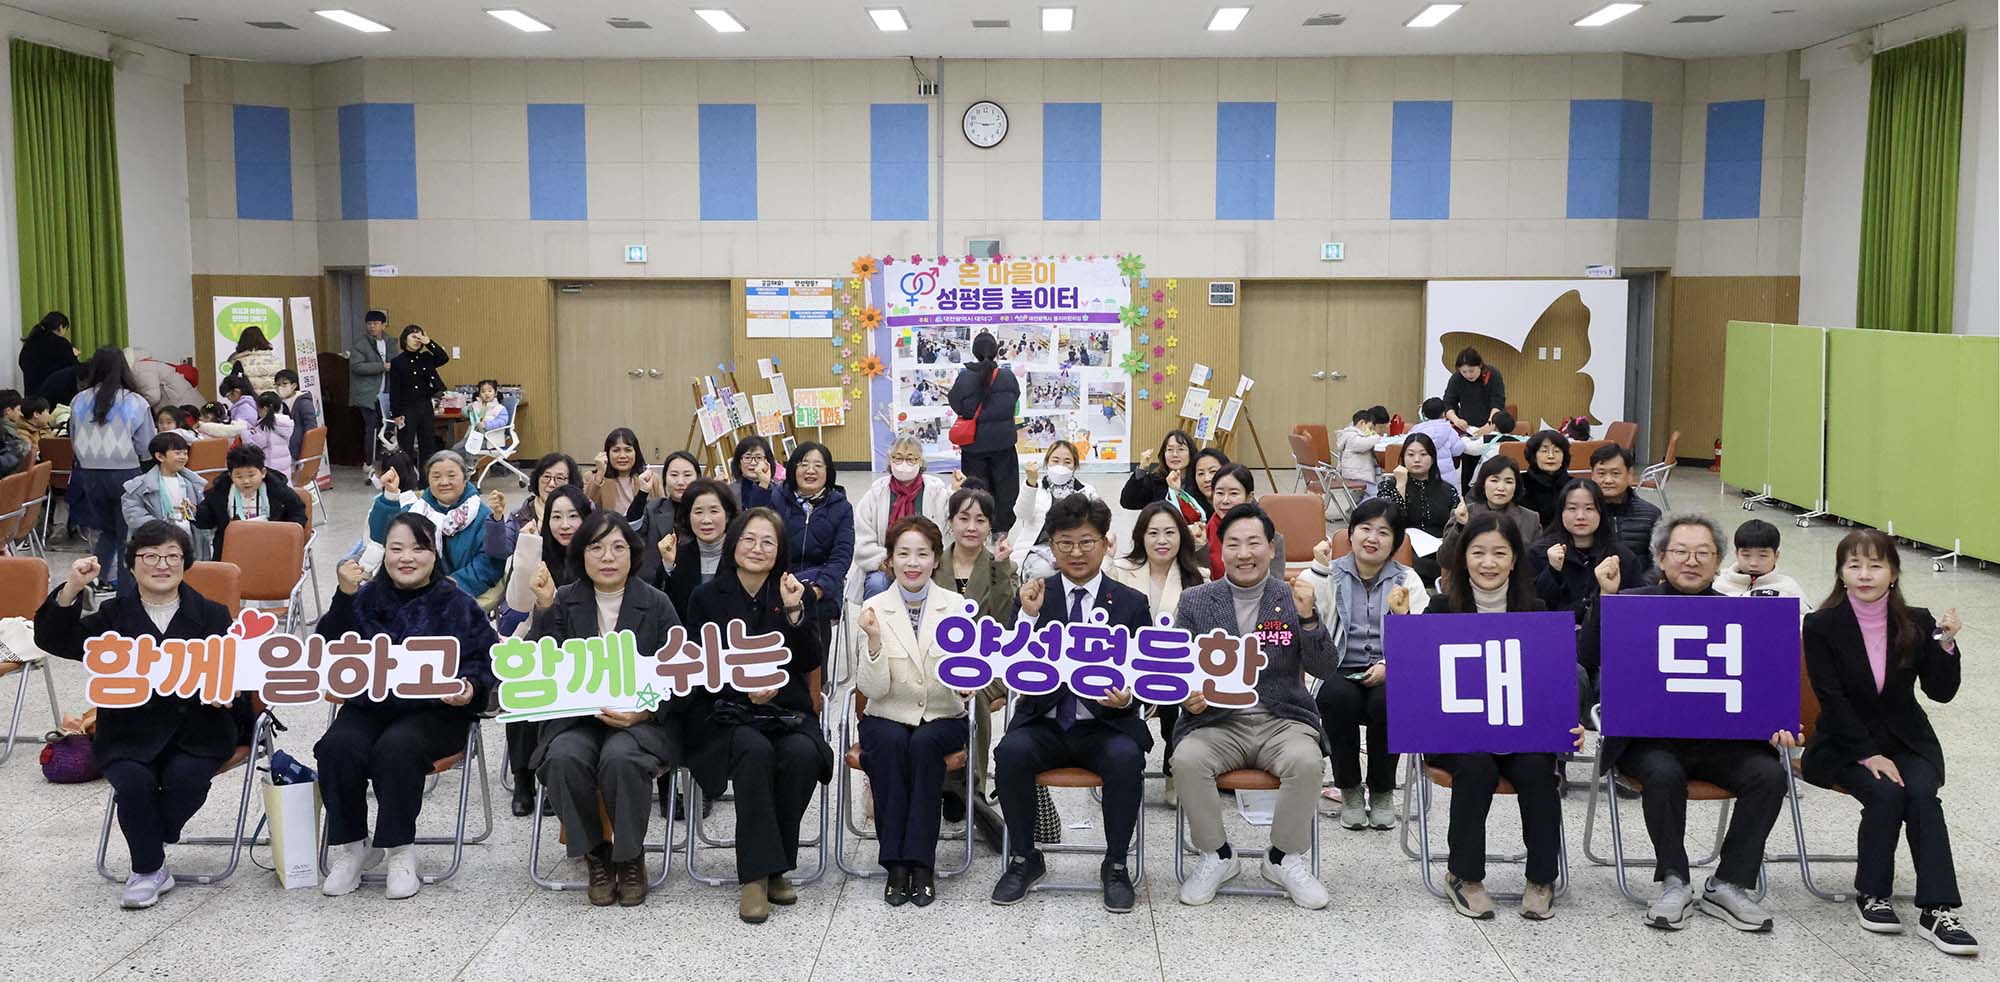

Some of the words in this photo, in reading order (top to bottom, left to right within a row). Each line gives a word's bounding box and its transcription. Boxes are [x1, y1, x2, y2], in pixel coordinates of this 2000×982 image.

[936, 288, 1003, 310] 성평등
[1011, 286, 1078, 309] 놀이터
[958, 263, 980, 286] 온
[988, 262, 1056, 285] 마을이
[492, 630, 637, 710] 함께
[655, 618, 789, 694] 쉬는
[935, 603, 1265, 706] 양성평등한
[1263, 620, 1283, 631] 의장
[86, 633, 237, 705] 함께
[257, 631, 463, 702] 일하고
[1439, 638, 1524, 727] 대
[1658, 623, 1742, 714] 덕
